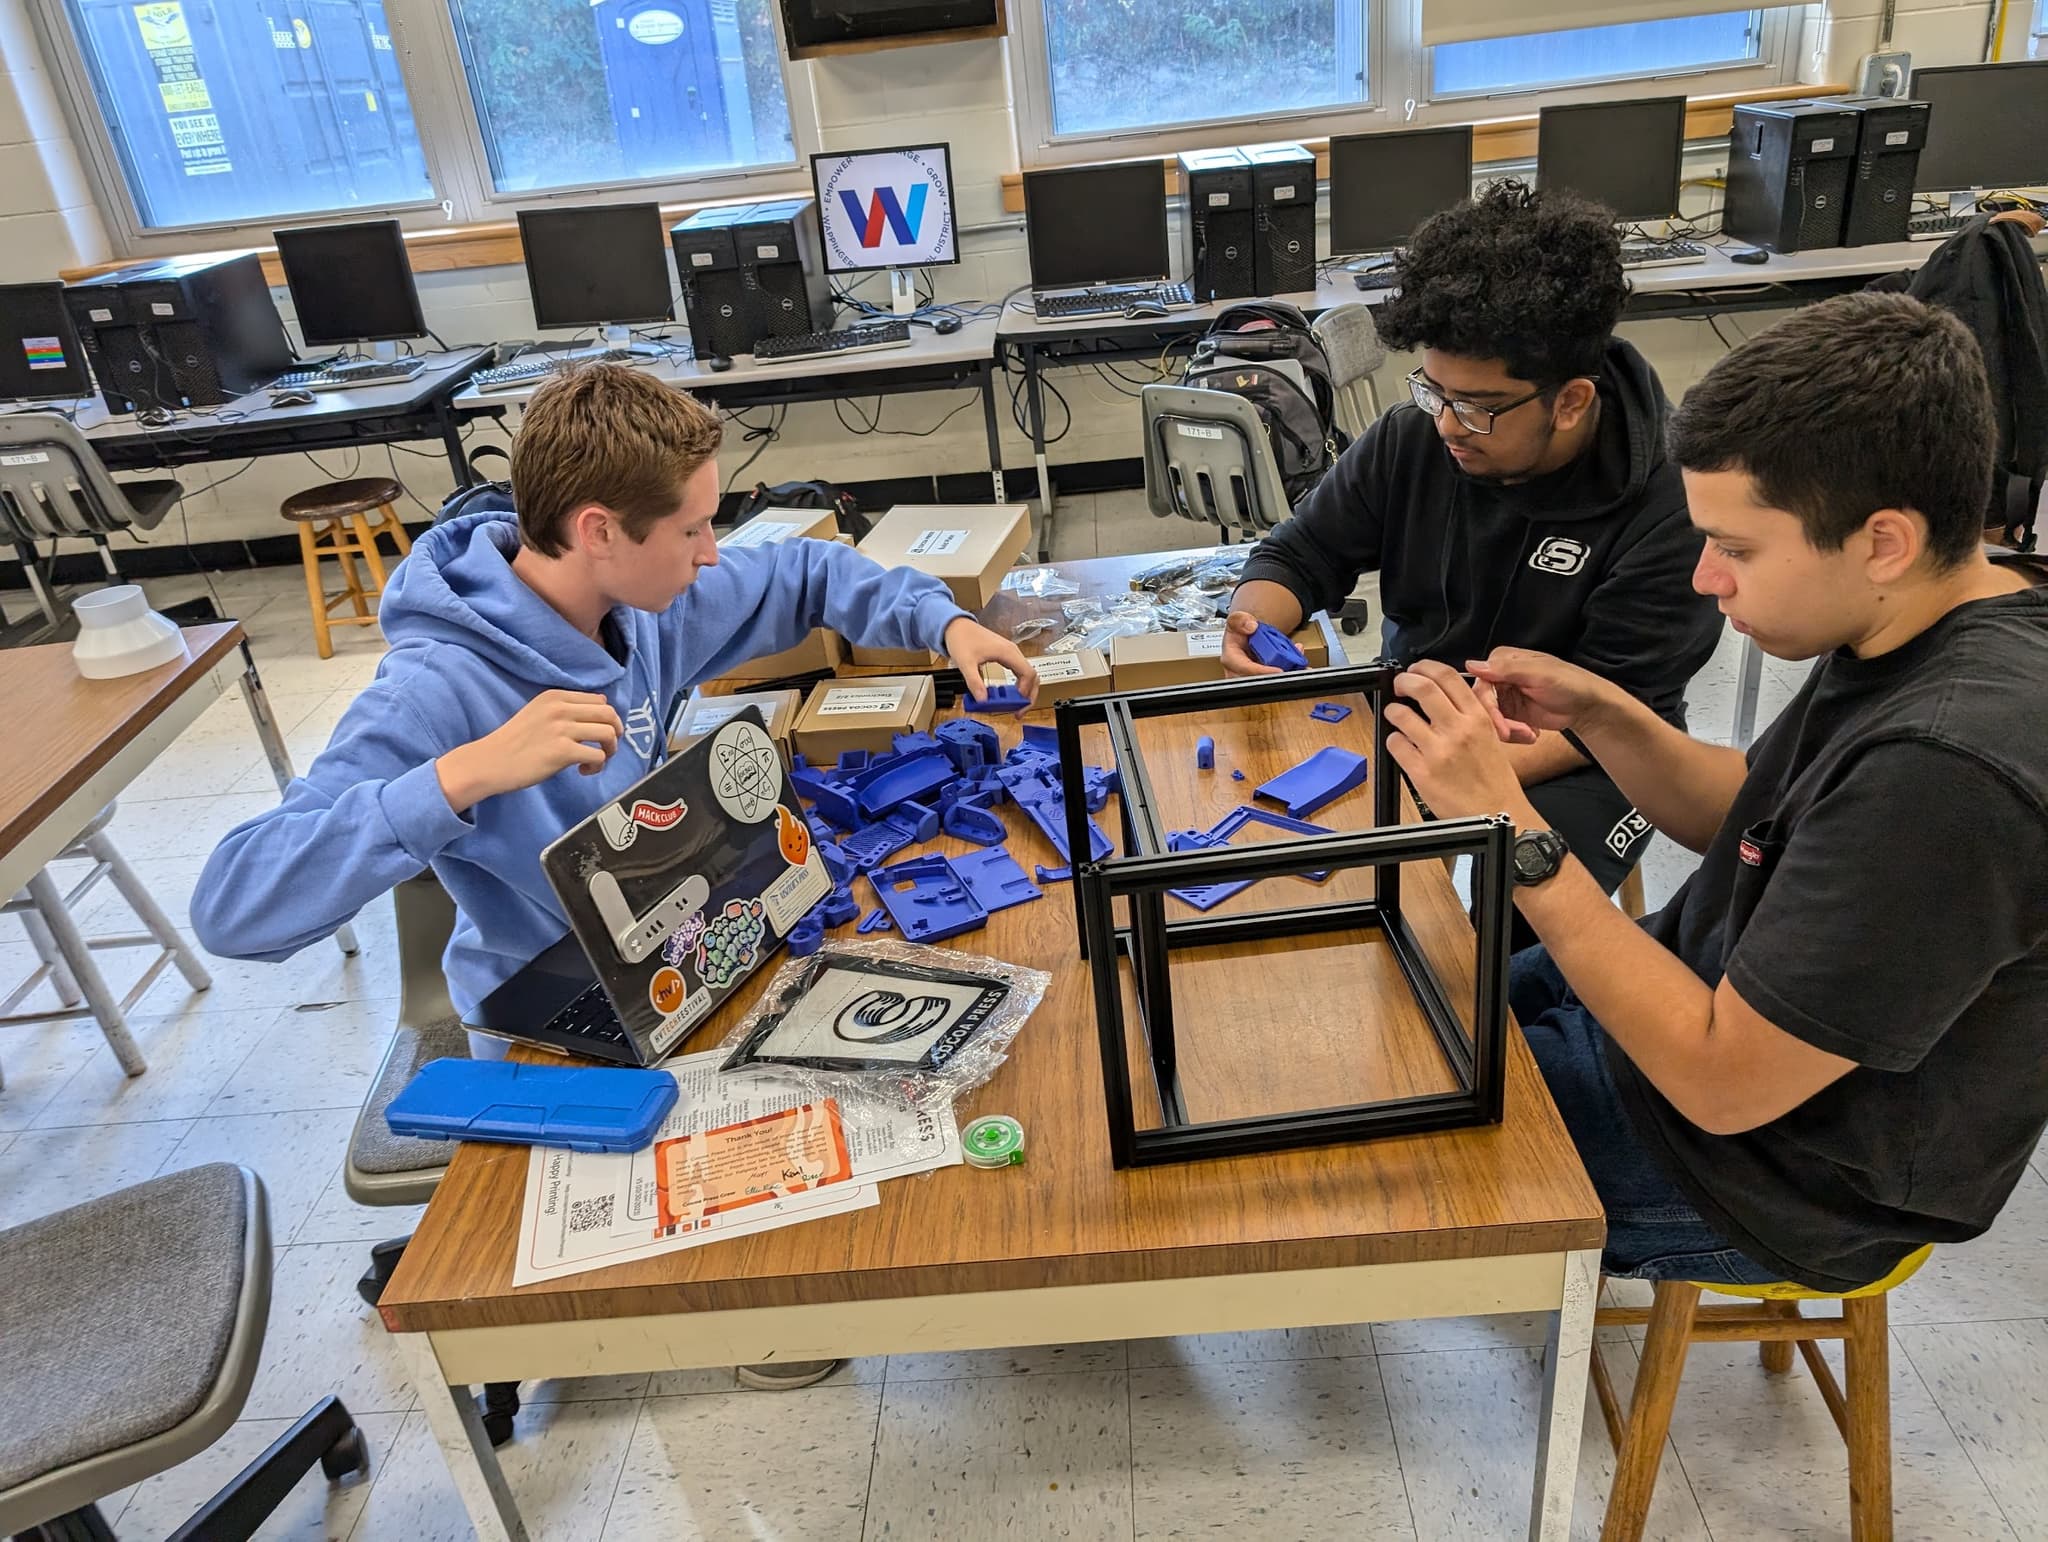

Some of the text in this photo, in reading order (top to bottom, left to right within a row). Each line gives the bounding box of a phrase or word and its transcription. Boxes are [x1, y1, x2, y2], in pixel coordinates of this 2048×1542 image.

[173, 117, 216, 130] YOU SEE US
[926, 167, 947, 198] GROW
[838, 183, 929, 248] W
[934, 211, 951, 254] DISTRICT
[936, 991, 1003, 1060] COCOA PRESS
[725, 1127, 773, 1144] Thank You!
[544, 1153, 564, 1216] Happy Printing!
